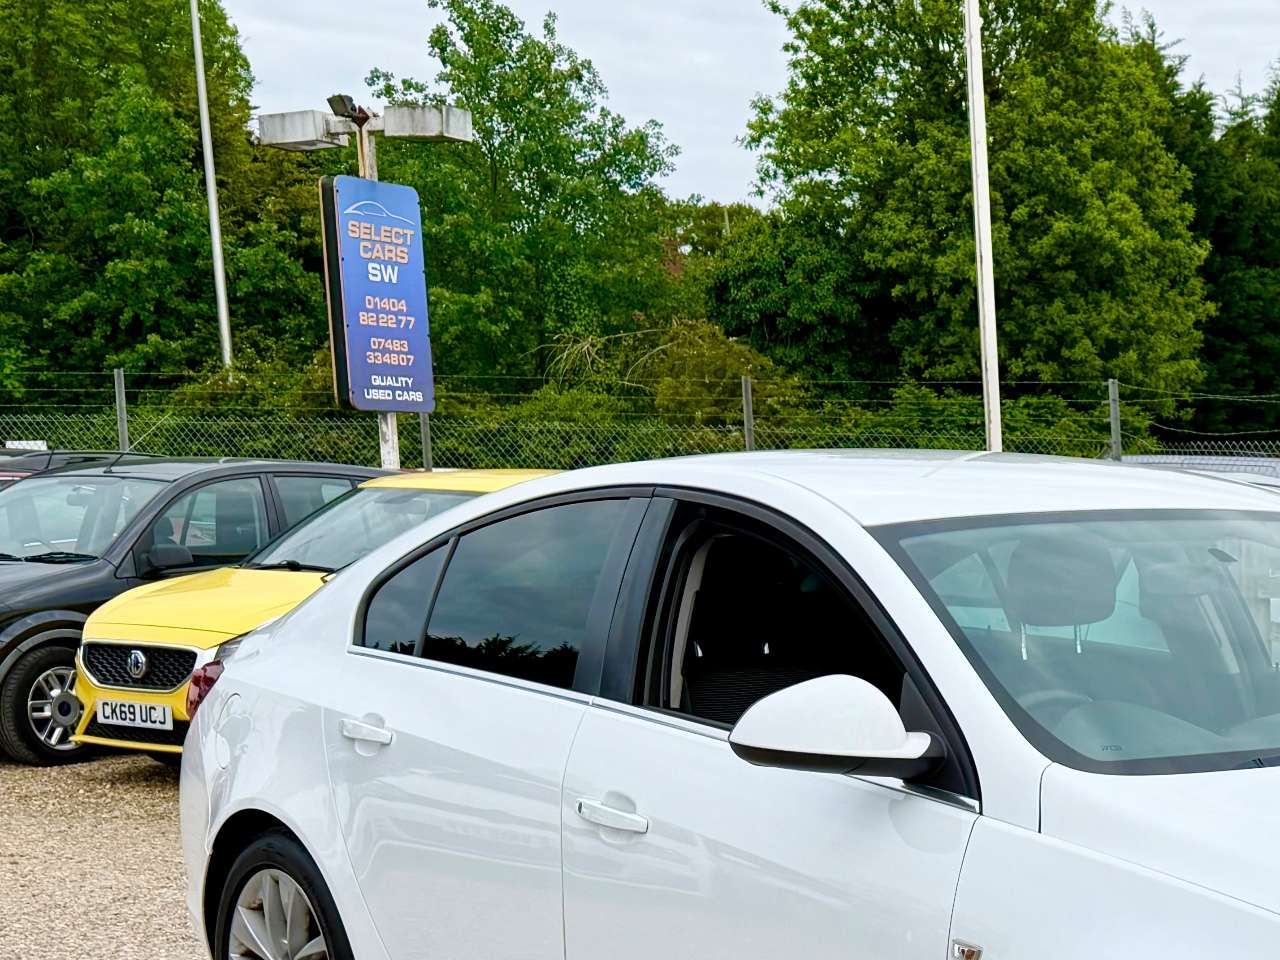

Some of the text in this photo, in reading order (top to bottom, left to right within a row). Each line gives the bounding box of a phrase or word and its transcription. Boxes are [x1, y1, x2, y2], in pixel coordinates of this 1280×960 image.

[348, 220, 415, 246] SELECT
[360, 241, 409, 264] CARS
[368, 262, 399, 284] SW
[365, 295, 407, 313] 01404
[379, 313, 397, 328] 22
[398, 315, 416, 330] 77
[366, 352, 415, 366] 334807
[371, 375, 414, 388] QUALITY
[364, 388, 424, 402] USED CARS
[101, 701, 166, 725] CK69 UCJ
